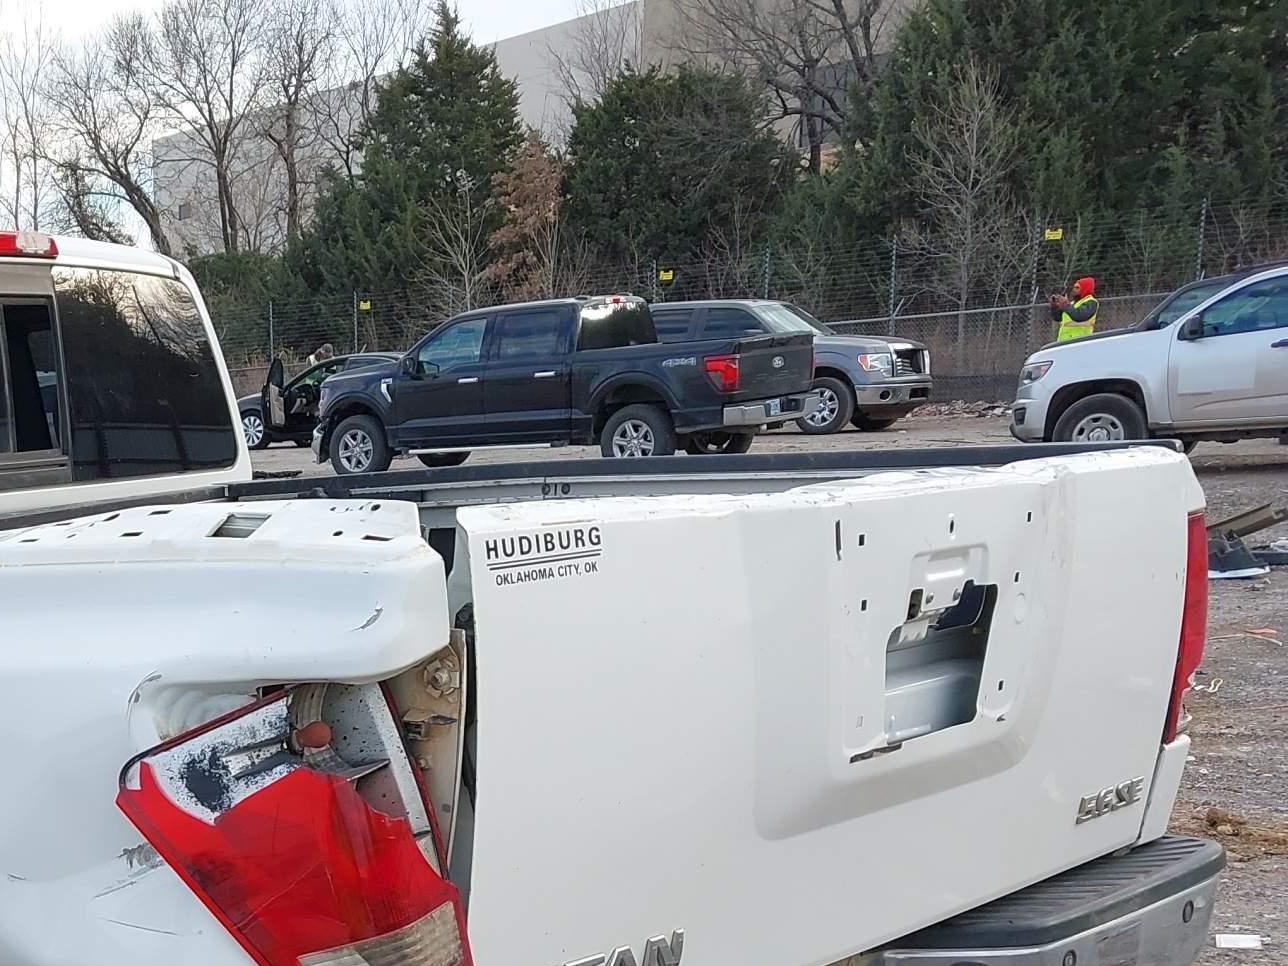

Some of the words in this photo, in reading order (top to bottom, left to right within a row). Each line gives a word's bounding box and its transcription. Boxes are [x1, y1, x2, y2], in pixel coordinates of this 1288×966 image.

[485, 526, 602, 560] HUDIBURG
[495, 567, 555, 586] OKLAHOMA
[584, 560, 599, 573] OK
